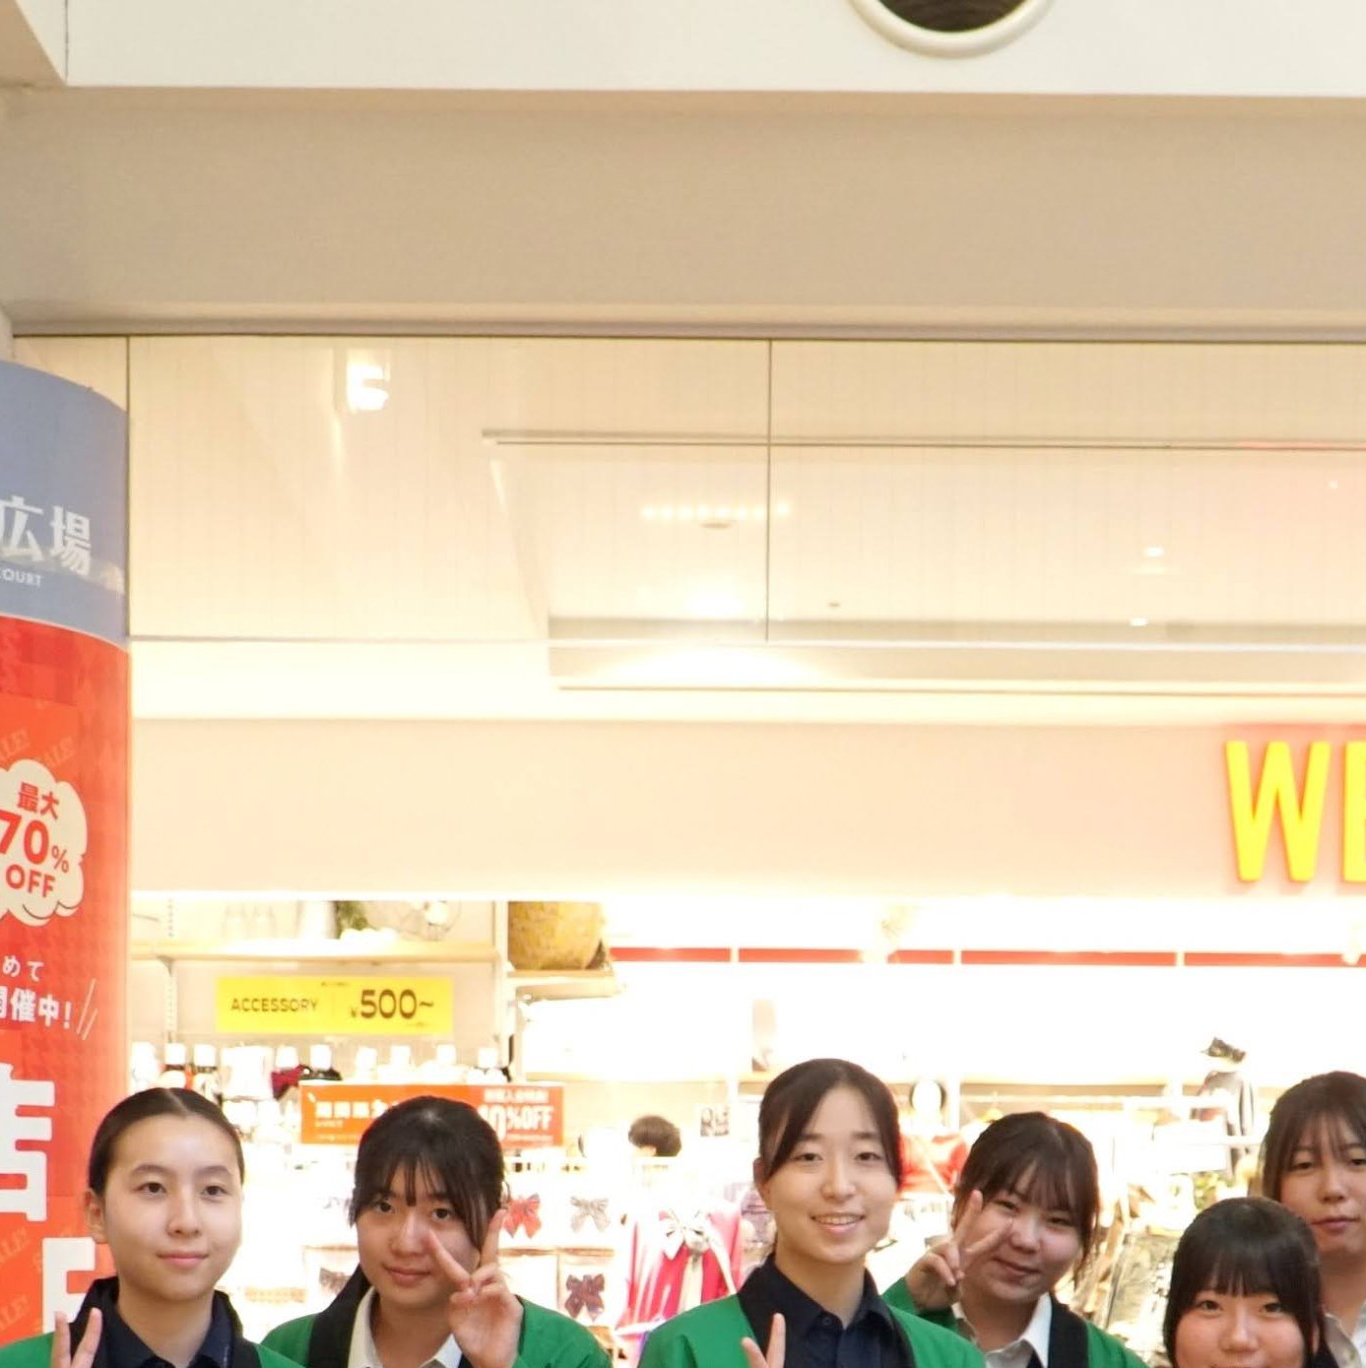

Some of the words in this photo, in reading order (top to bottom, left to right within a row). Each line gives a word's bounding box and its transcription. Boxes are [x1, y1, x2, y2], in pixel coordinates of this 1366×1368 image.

[16, 782, 60, 820] 最大
[5, 864, 56, 898] OFF
[231, 997, 318, 1013] ACCESSORY
